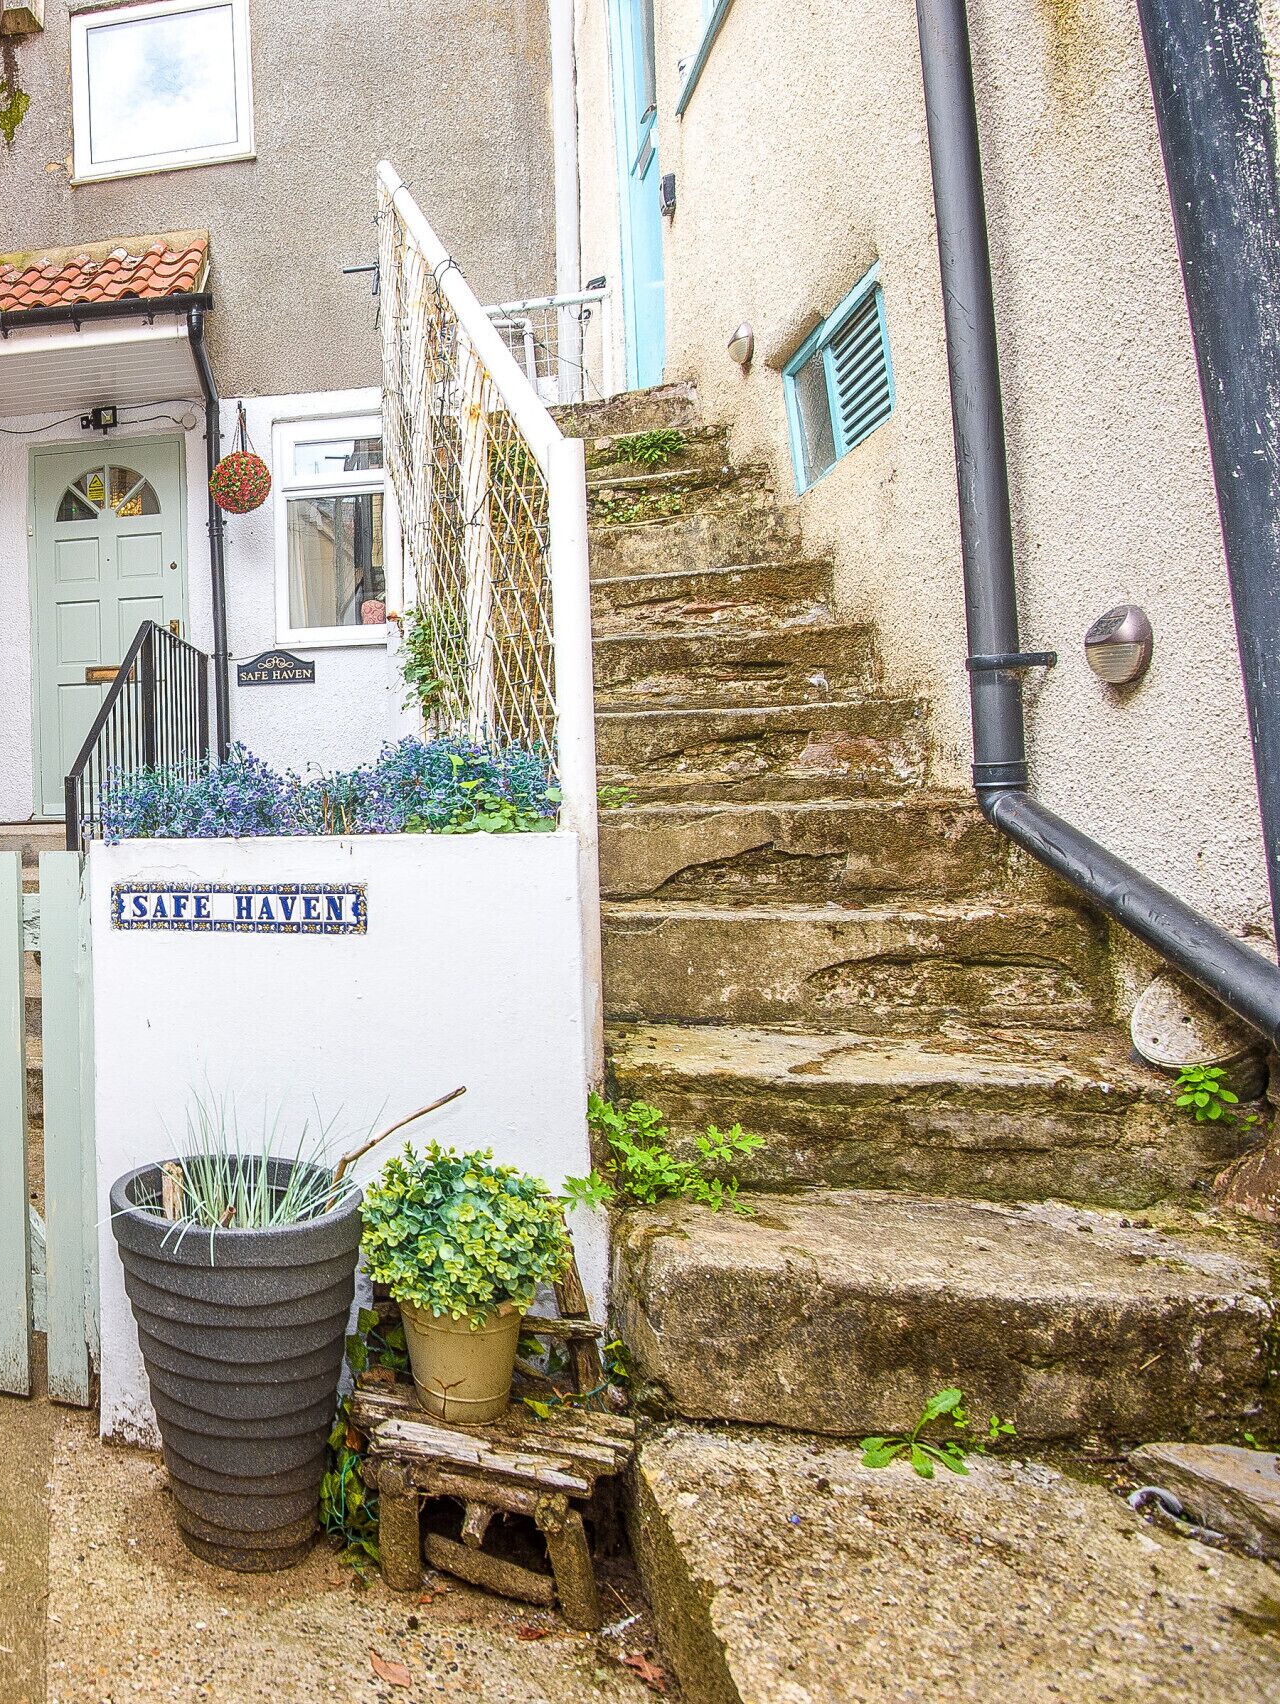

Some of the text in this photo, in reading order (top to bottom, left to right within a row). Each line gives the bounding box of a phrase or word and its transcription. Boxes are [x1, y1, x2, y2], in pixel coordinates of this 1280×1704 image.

[240, 669, 313, 681] SAFE HAVEN
[131, 895, 344, 921] SAFE HAVEN
